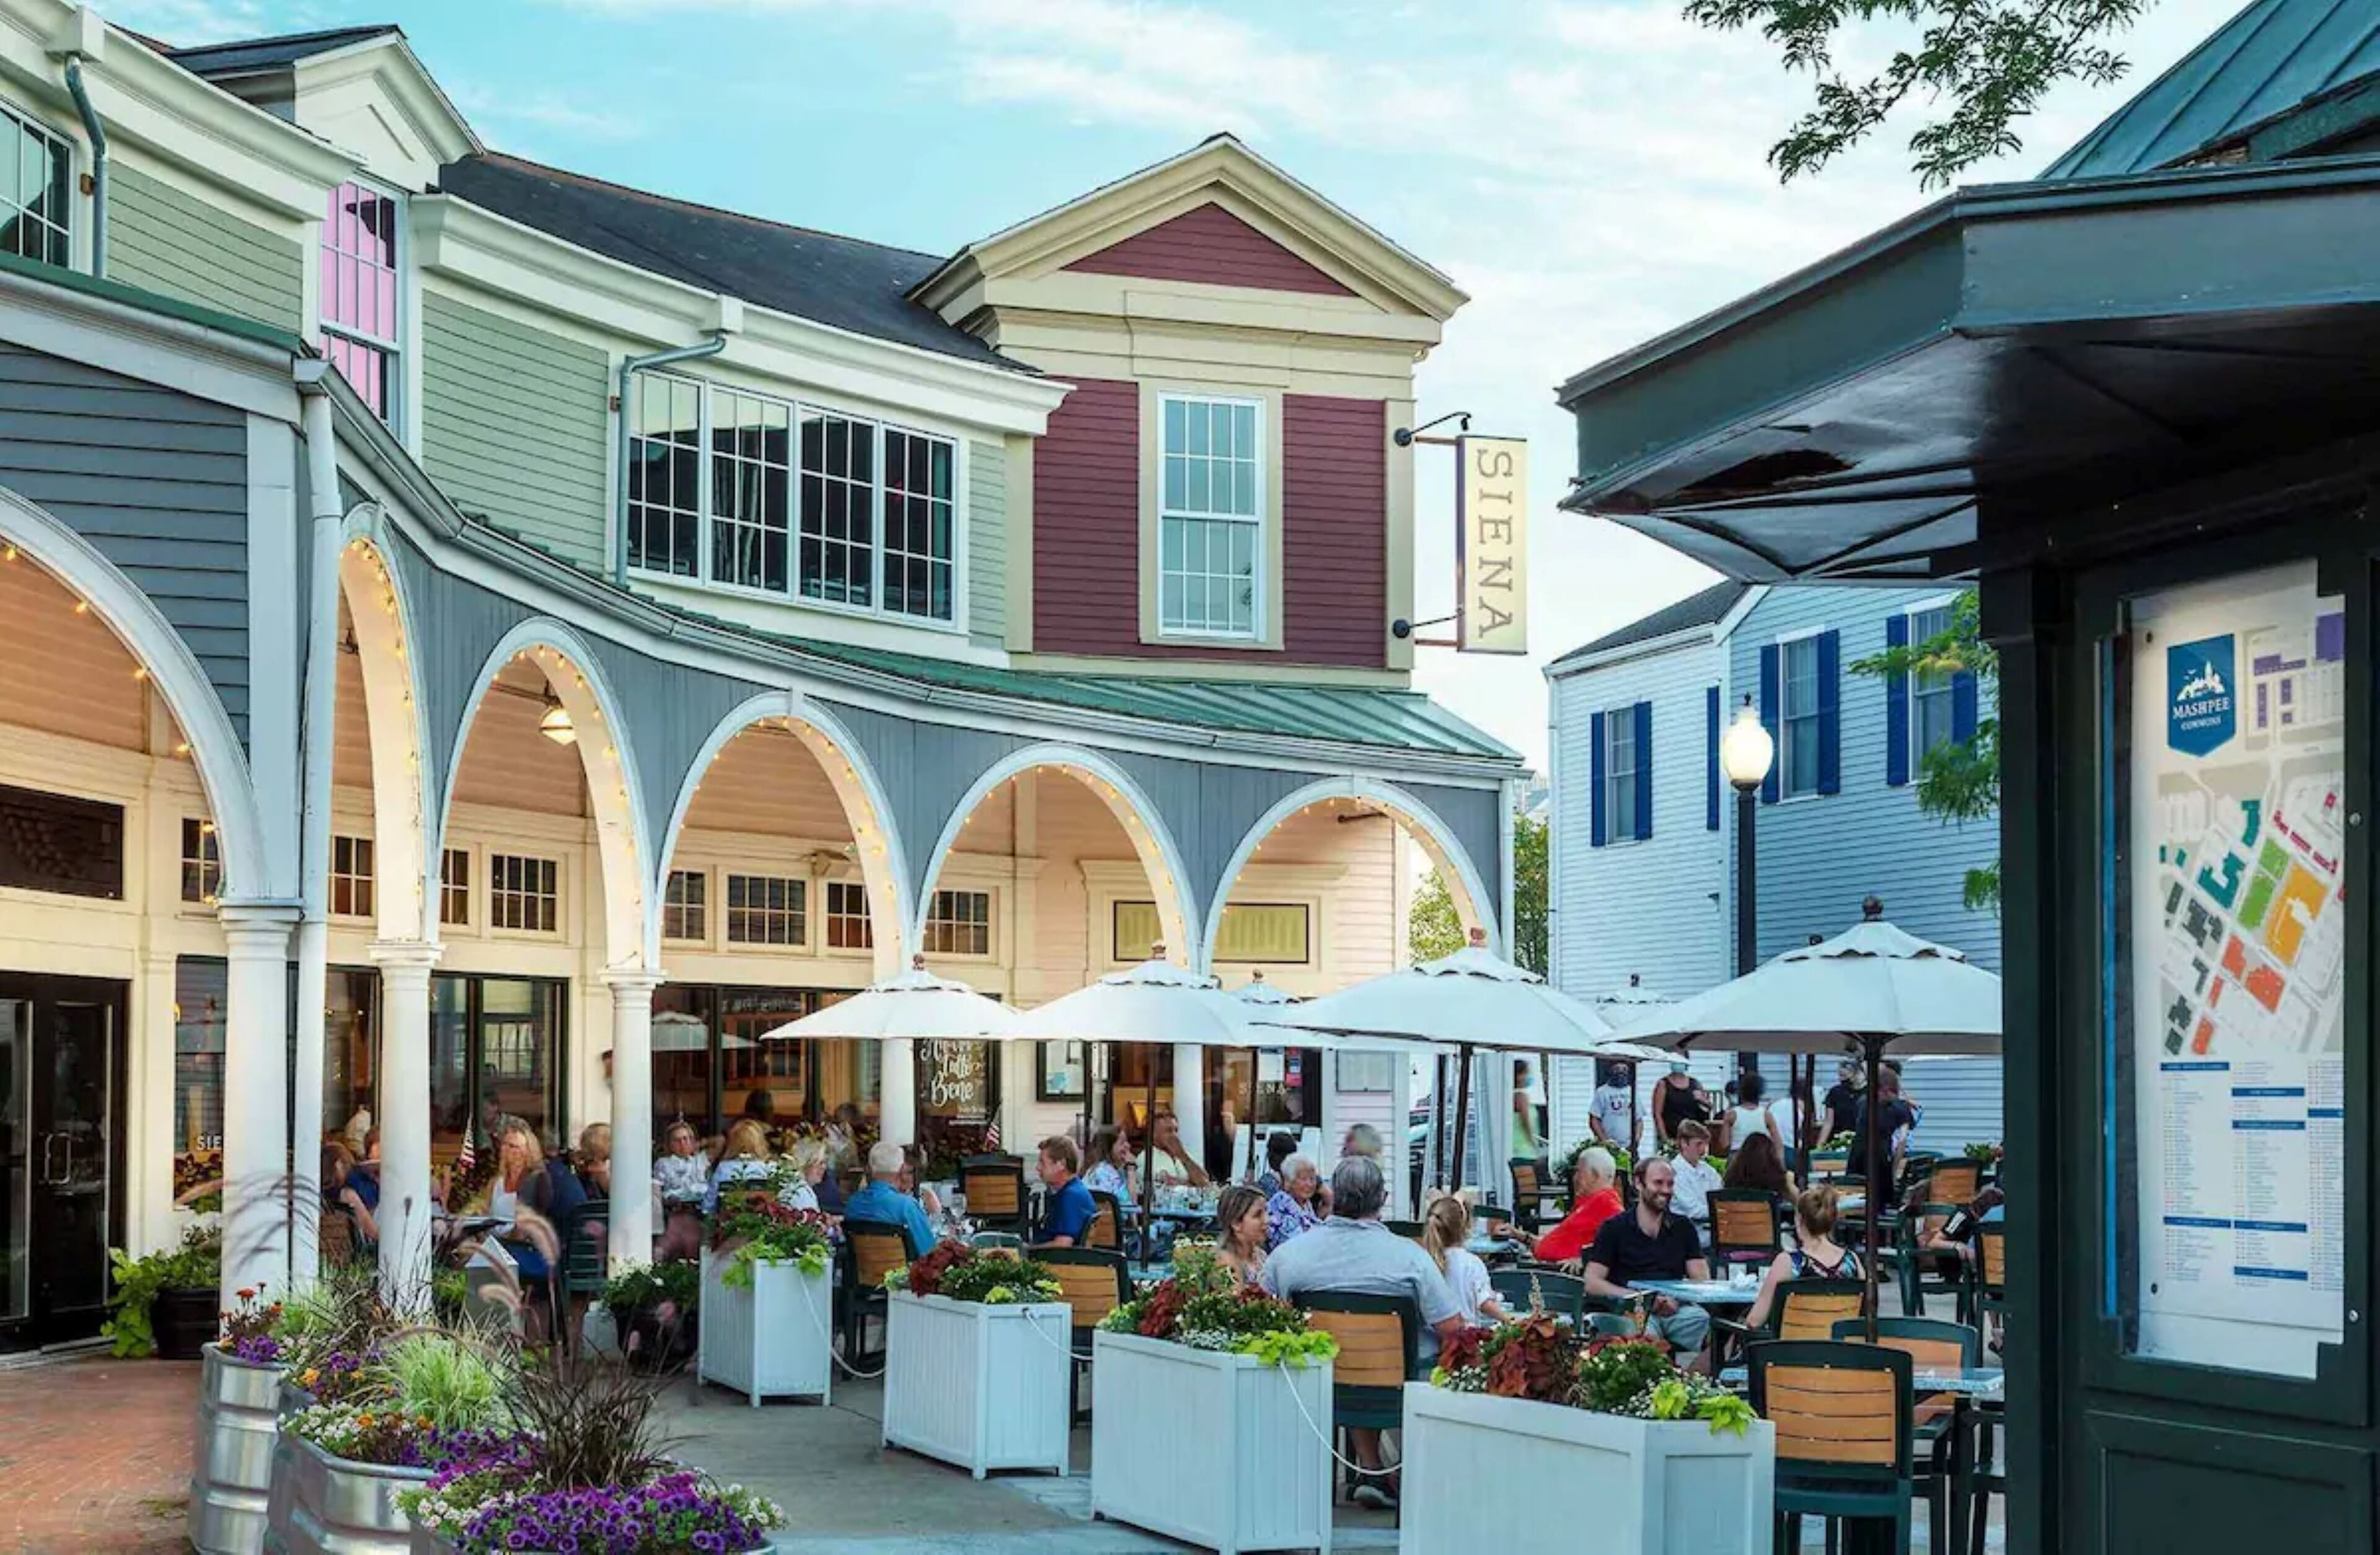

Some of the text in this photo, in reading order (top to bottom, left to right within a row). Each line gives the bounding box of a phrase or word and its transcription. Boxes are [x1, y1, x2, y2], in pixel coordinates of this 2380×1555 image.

[1477, 449, 1513, 638] SIENA
[2172, 697, 2231, 719] MASHPEE
[1238, 1082, 1287, 1095] SENA
[198, 1135, 222, 1150] SIE
